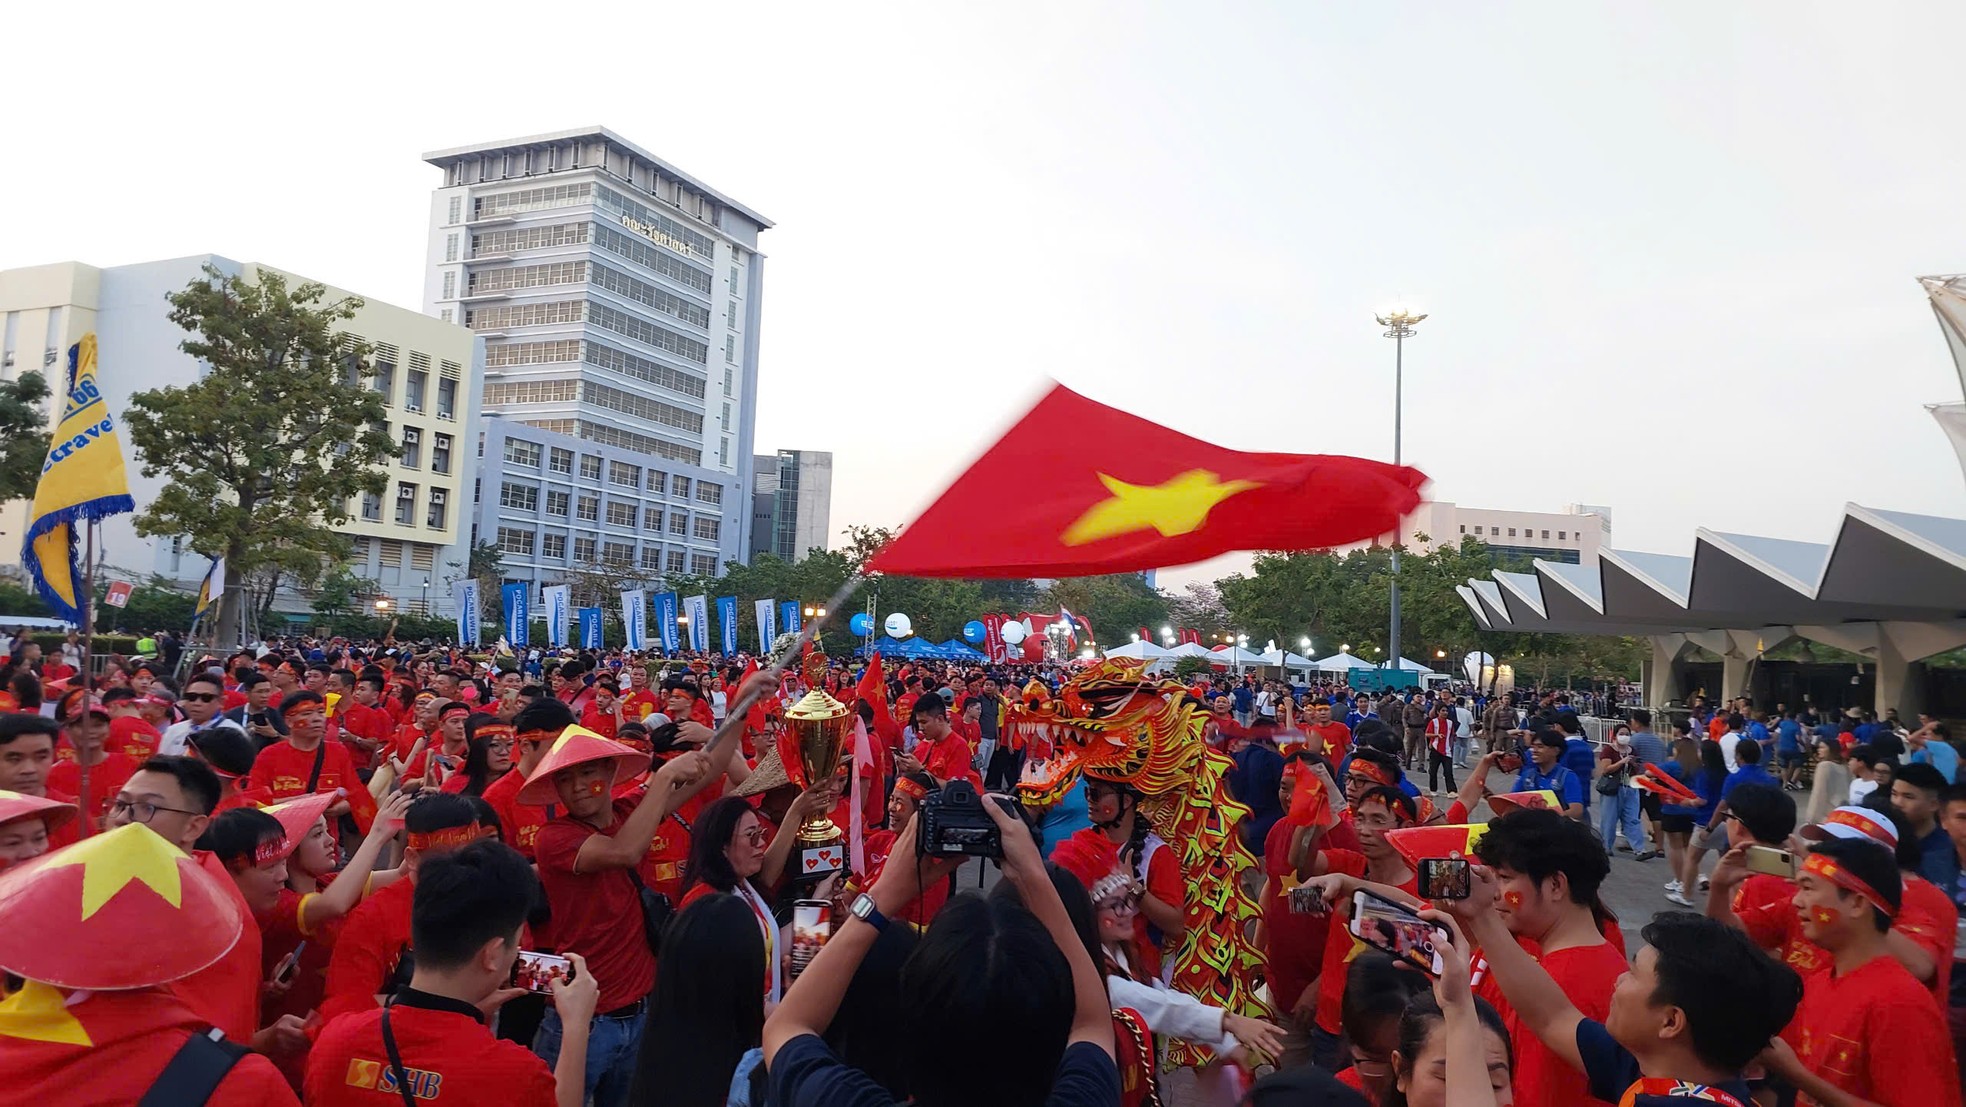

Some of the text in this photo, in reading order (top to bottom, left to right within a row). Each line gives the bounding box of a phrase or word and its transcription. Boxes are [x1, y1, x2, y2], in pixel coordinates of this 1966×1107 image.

[466, 585, 478, 641] POCARI SWEAT
[515, 589, 525, 644] POCARI SWEAT
[557, 591, 565, 619] POCARI
[634, 596, 643, 623] POCARI
[696, 601, 705, 628] POCARI
[727, 602, 736, 628] POCARI
[791, 606, 799, 631] POCARI
[591, 613, 599, 641] POCARI
[665, 598, 680, 652] POCARI SWEAT
[378, 1065, 442, 1100] SHB
